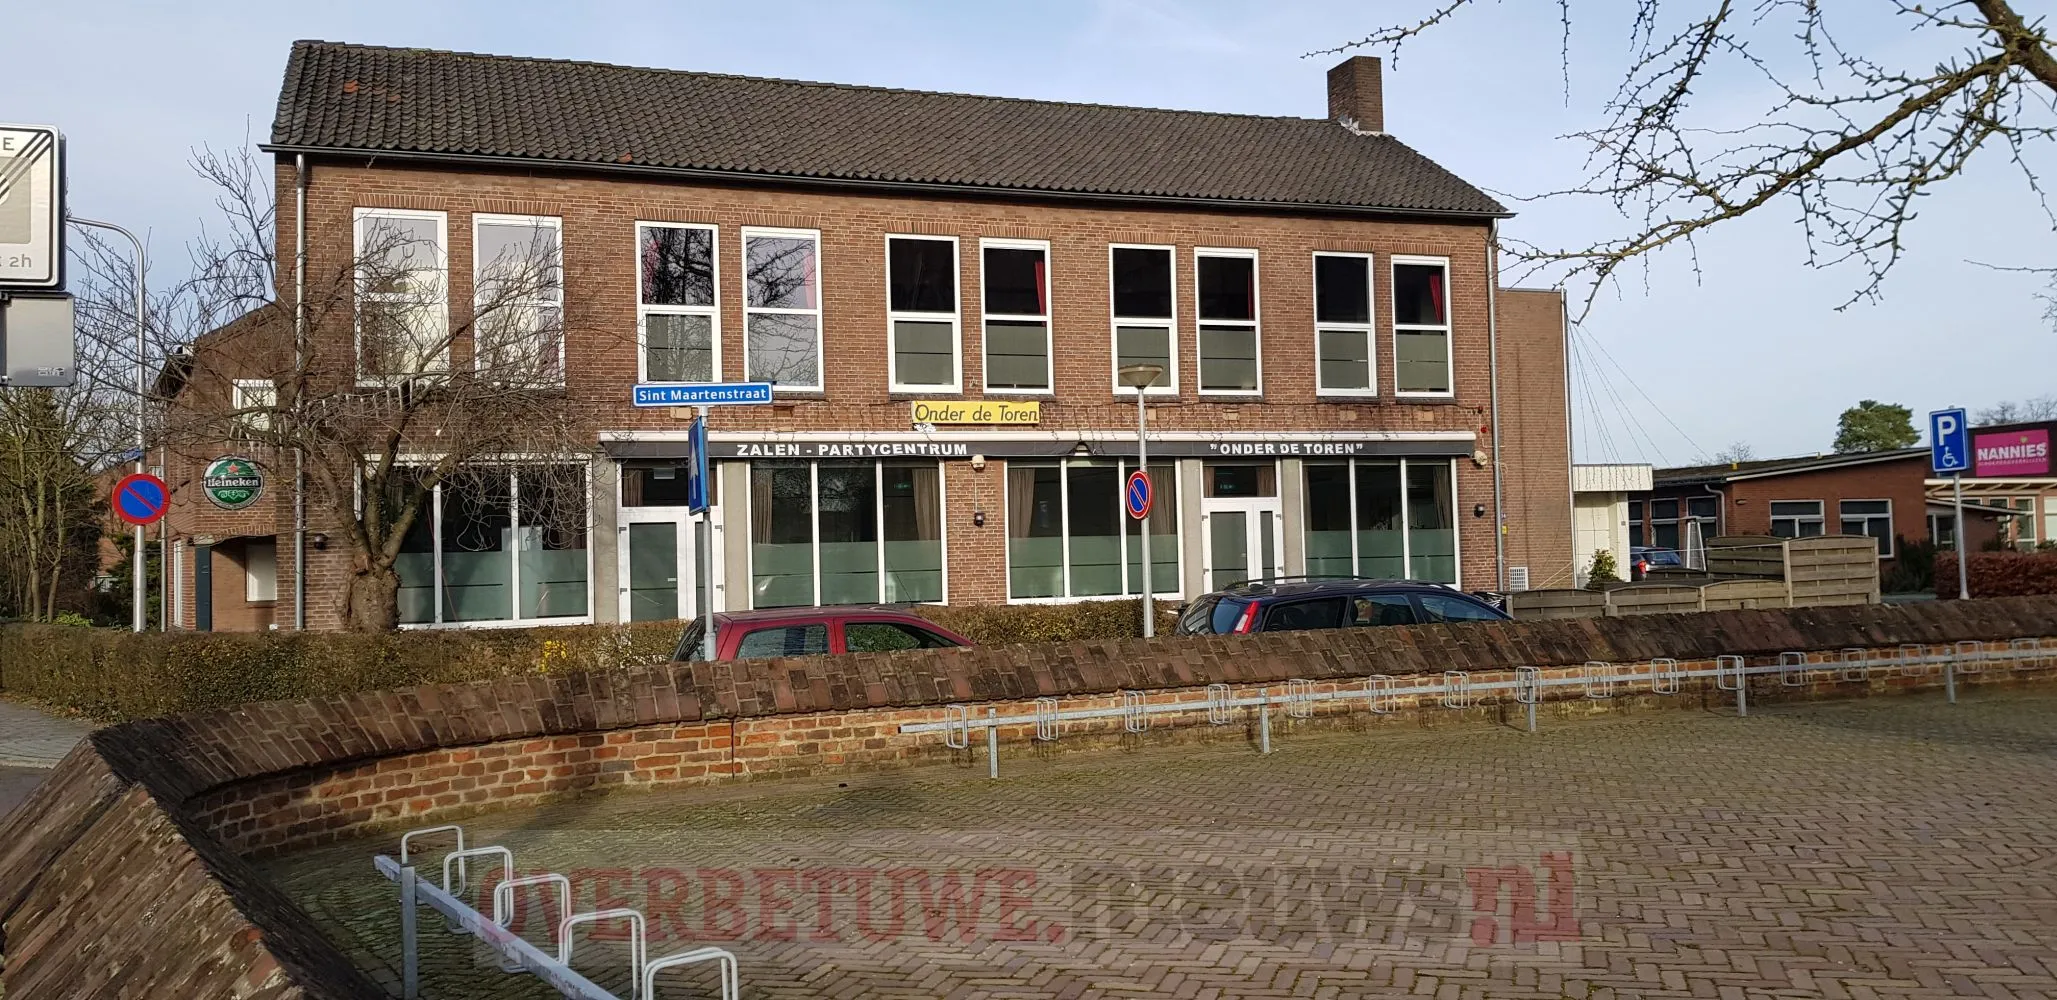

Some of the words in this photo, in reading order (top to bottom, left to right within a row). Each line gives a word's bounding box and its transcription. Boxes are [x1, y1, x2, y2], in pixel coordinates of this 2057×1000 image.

[639, 390, 666, 401] Sint
[670, 388, 767, 400] Maartenstraat
[915, 404, 965, 421] Onder
[972, 405, 992, 421] de
[998, 405, 1038, 421] Toren
[1937, 415, 1956, 446] P
[736, 444, 800, 456] ZALEN
[818, 443, 968, 456] PARTYCENTRUM
[1280, 443, 1300, 454] DE
[1977, 442, 2047, 461] NANNIES
[207, 475, 260, 487] Heineken
